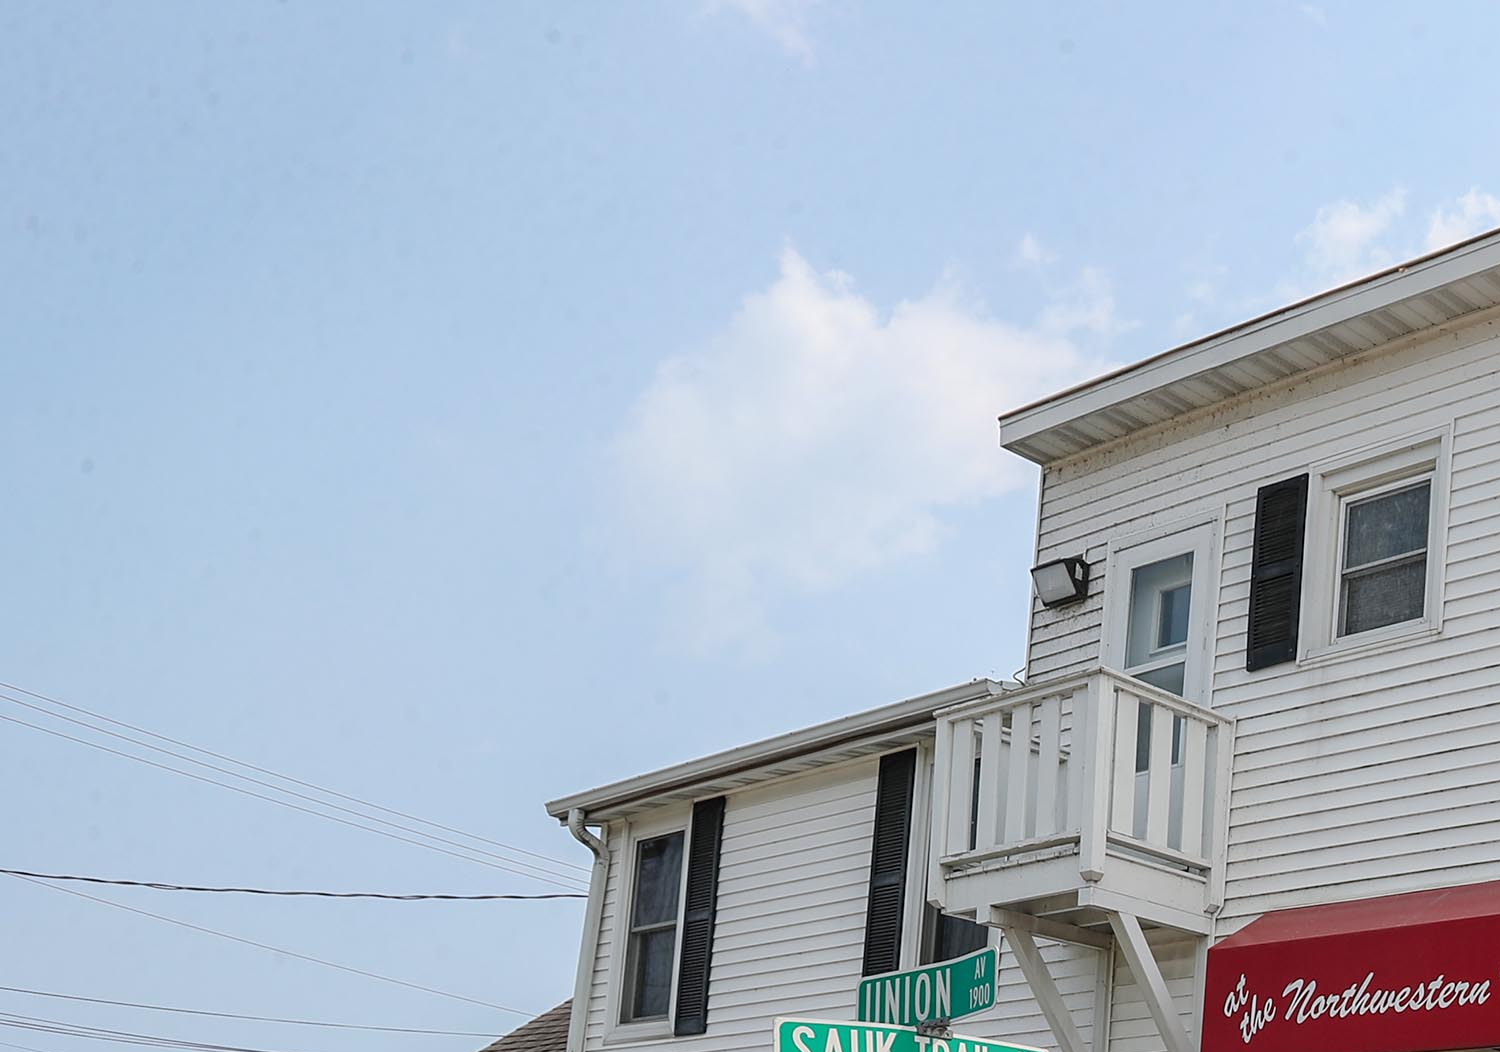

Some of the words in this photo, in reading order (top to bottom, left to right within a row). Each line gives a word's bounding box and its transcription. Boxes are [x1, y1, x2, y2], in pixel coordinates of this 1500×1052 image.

[974, 956, 986, 980] AV
[865, 968, 951, 1024] UNION
[969, 983, 990, 1009] 1900
[1224, 974, 1249, 1017] at
[1240, 995, 1276, 1043] the
[1282, 972, 1491, 1024] Northwestern
